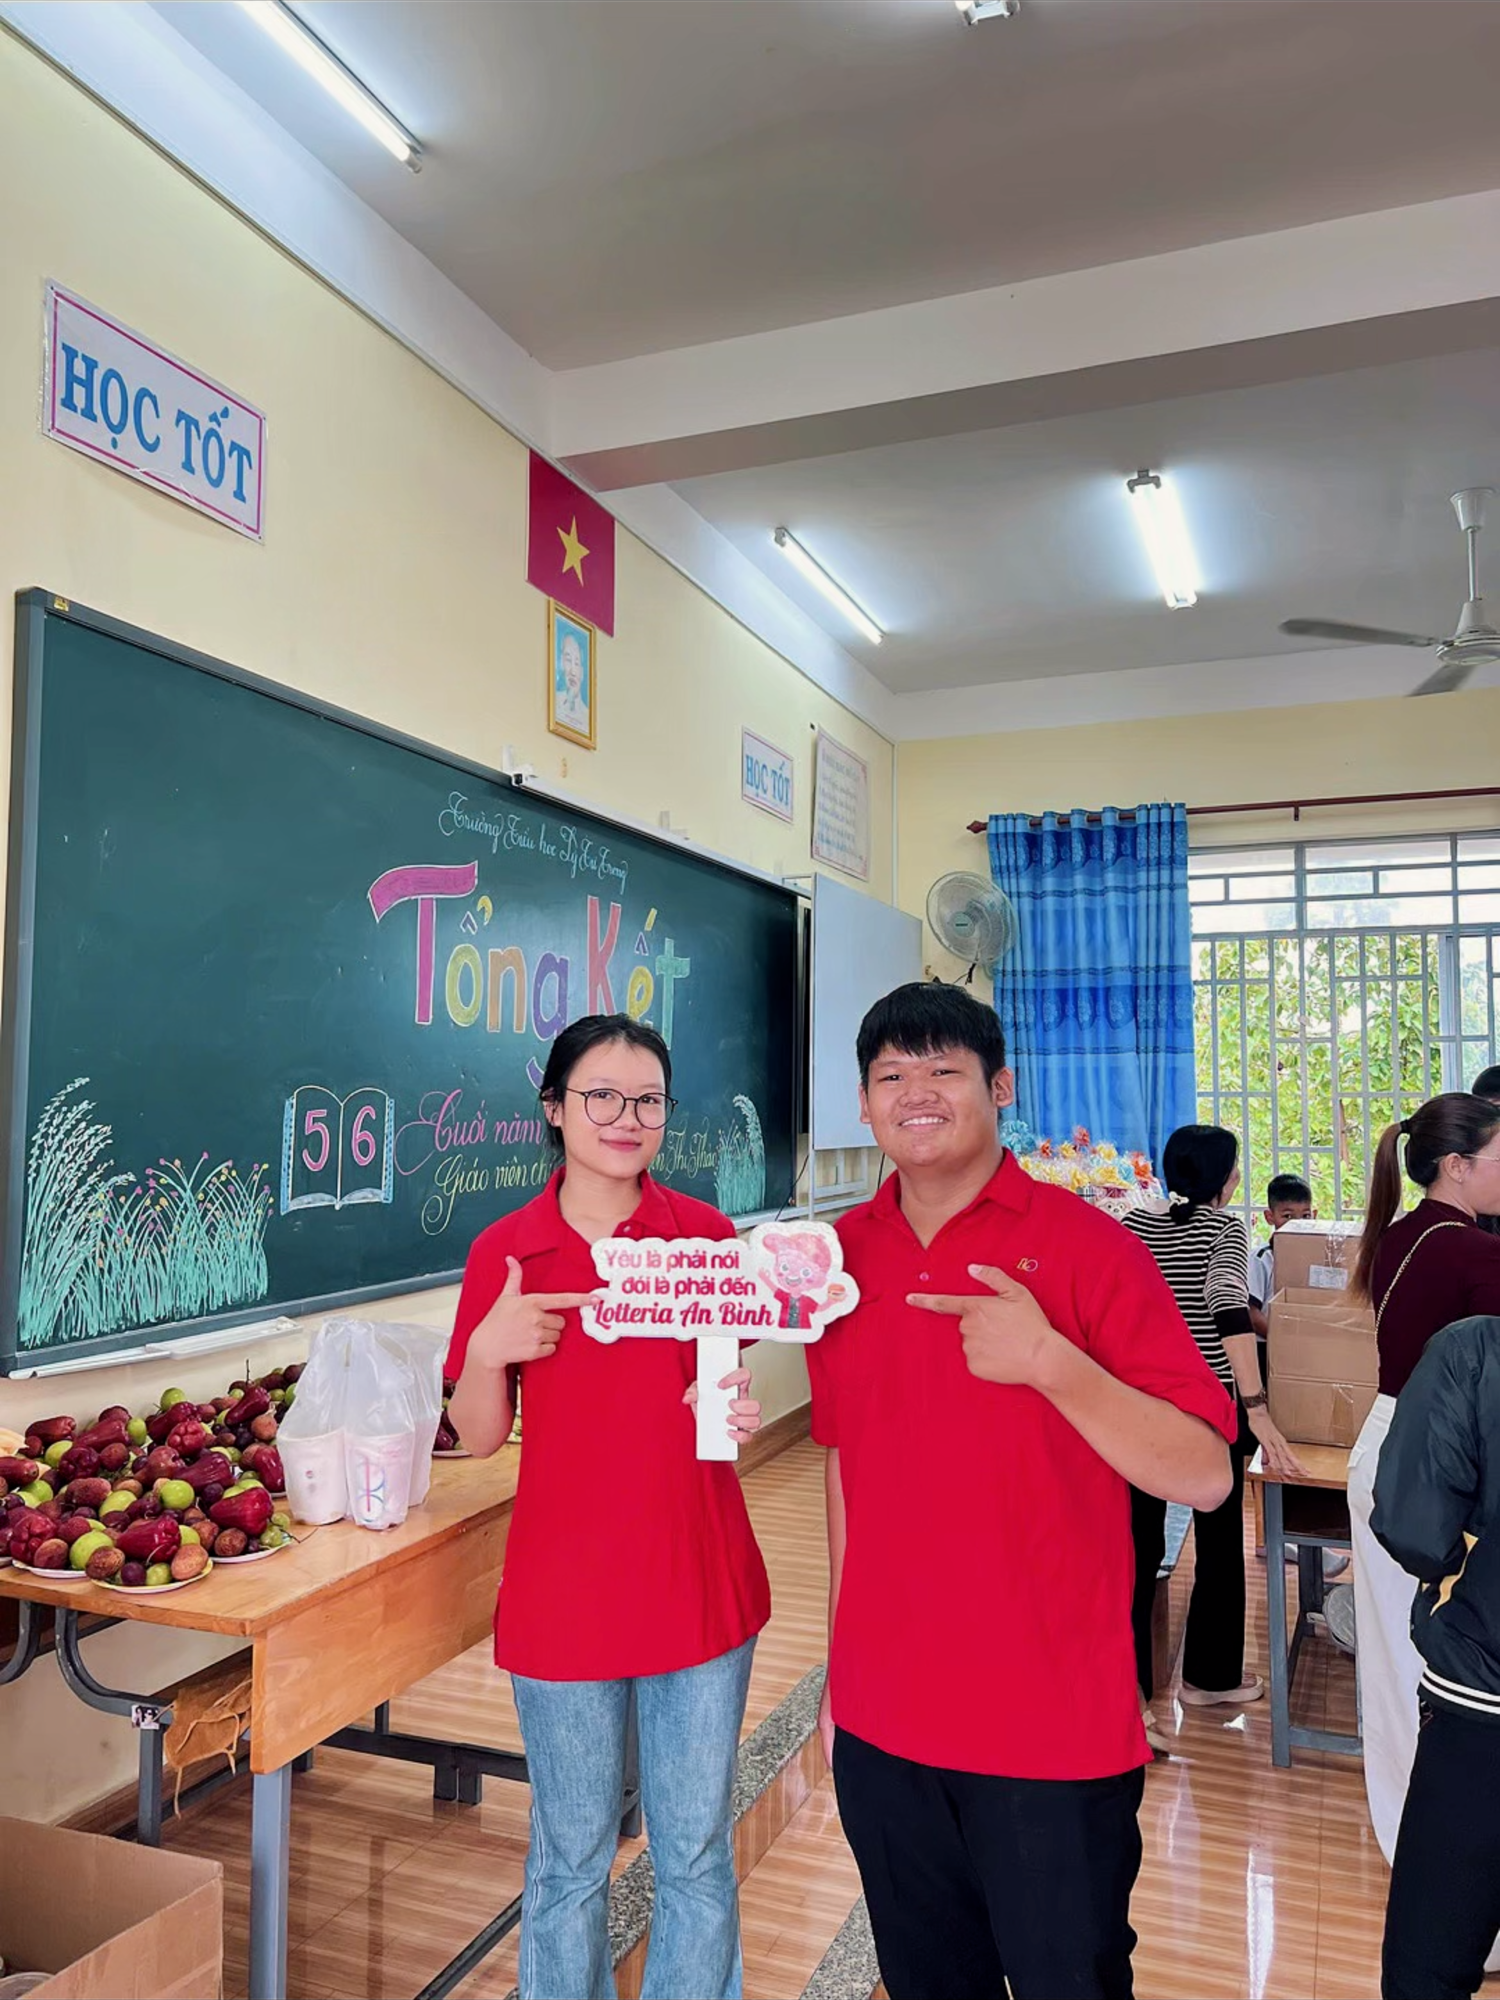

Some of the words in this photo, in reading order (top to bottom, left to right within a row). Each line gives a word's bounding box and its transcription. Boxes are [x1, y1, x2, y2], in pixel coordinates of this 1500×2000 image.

[60, 342, 160, 453] HỌC
[175, 406, 253, 504] TỐT
[746, 754, 768, 798] HỌC
[367, 860, 570, 1093] Tổng
[586, 894, 691, 1051] Kết
[302, 1108, 330, 1172] 5
[351, 1104, 376, 1167] 6
[493, 1111, 543, 1146] năm
[421, 1153, 489, 1236] Giáo
[494, 1155, 527, 1189] viên
[530, 1149, 557, 1187] ch
[603, 1249, 642, 1268] Yêu
[646, 1250, 662, 1268] là
[666, 1250, 707, 1273] phải
[711, 1251, 740, 1269] nói
[621, 1276, 650, 1295] đói
[655, 1277, 670, 1295] là
[674, 1277, 715, 1299] phải
[719, 1276, 756, 1296] đến
[593, 1300, 675, 1330] Lotteria
[680, 1301, 714, 1328] An
[718, 1302, 775, 1327] Bình
